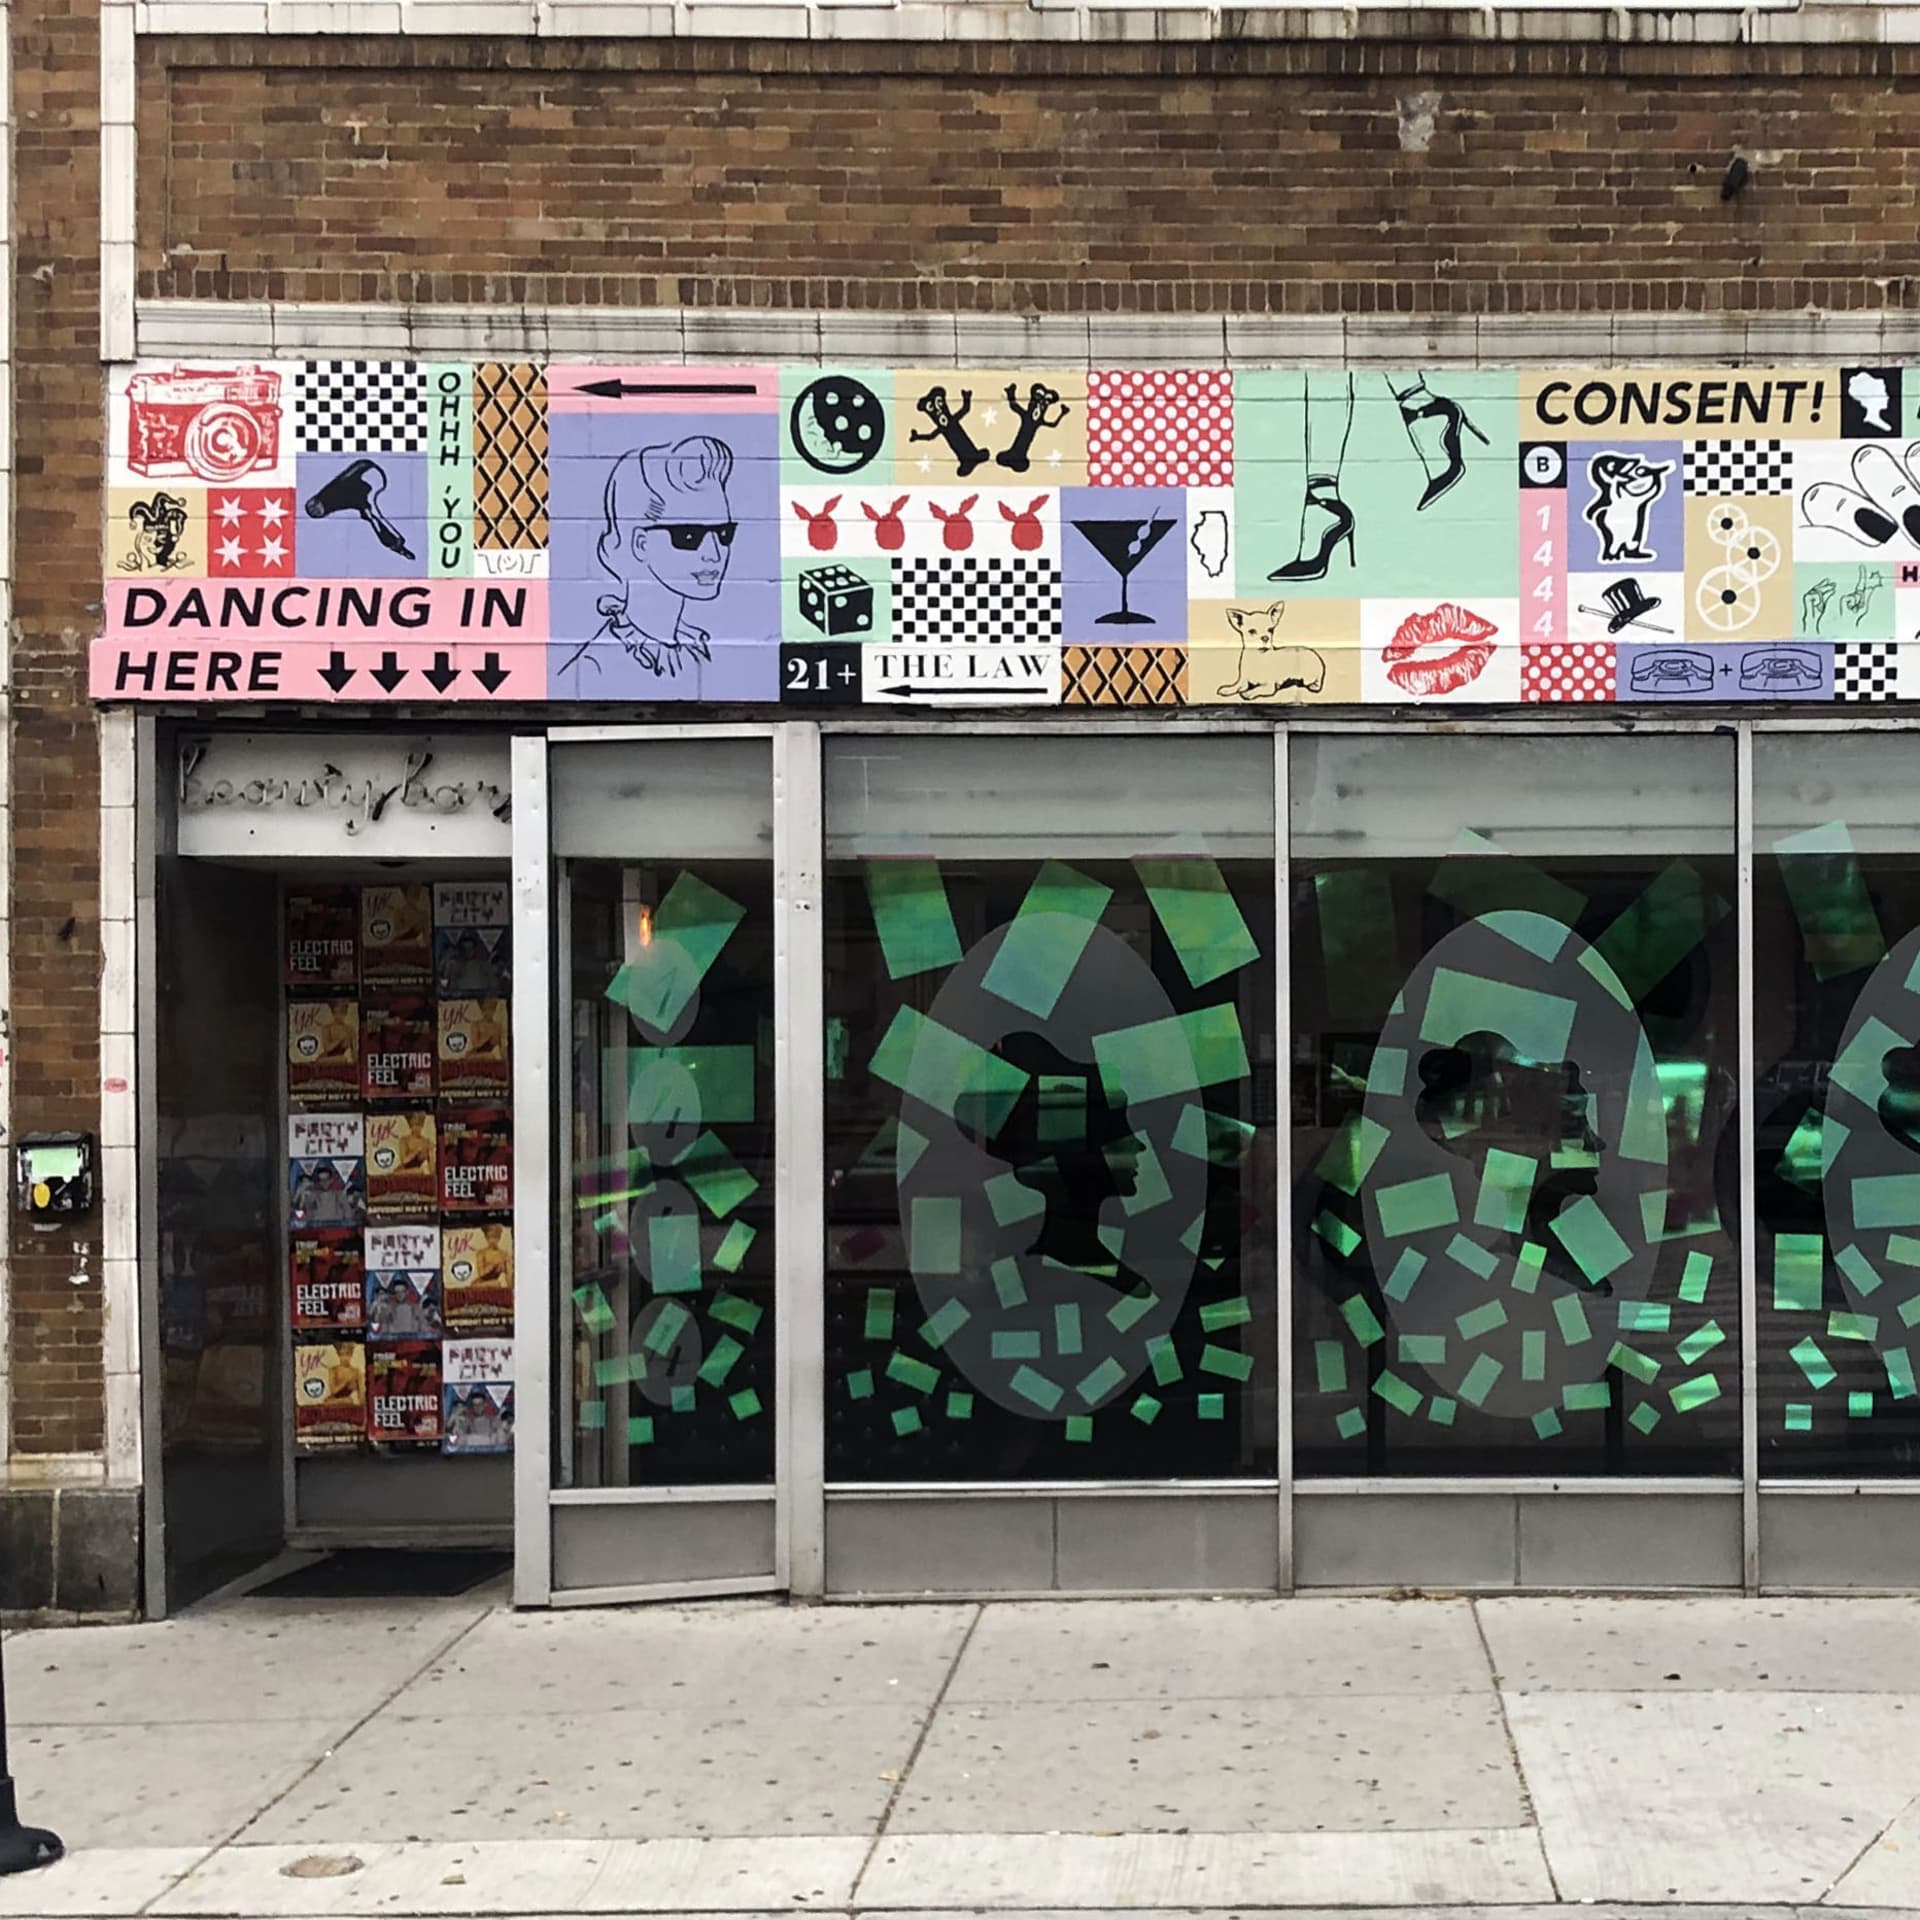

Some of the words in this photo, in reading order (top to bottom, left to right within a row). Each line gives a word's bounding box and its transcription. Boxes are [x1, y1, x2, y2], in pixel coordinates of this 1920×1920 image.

[1535, 380, 1825, 424] CONSENT!
[1536, 457, 1550, 473] B
[123, 586, 431, 629] DANCING
[459, 587, 527, 627] IN
[114, 651, 282, 692] HERE
[786, 657, 857, 690] 21+
[874, 654, 953, 678] THE
[967, 654, 1051, 678] LAW
[367, 1052, 431, 1069] ELECTRIC
[368, 1069, 399, 1085] FEEL
[444, 1165, 508, 1181] ELECTRIC
[444, 1182, 475, 1198] FEEL
[297, 1283, 361, 1300] ELECTRIC
[297, 1300, 329, 1316] FEEL
[373, 1395, 438, 1412] ELECTRIC
[374, 1412, 405, 1428] FEEL
